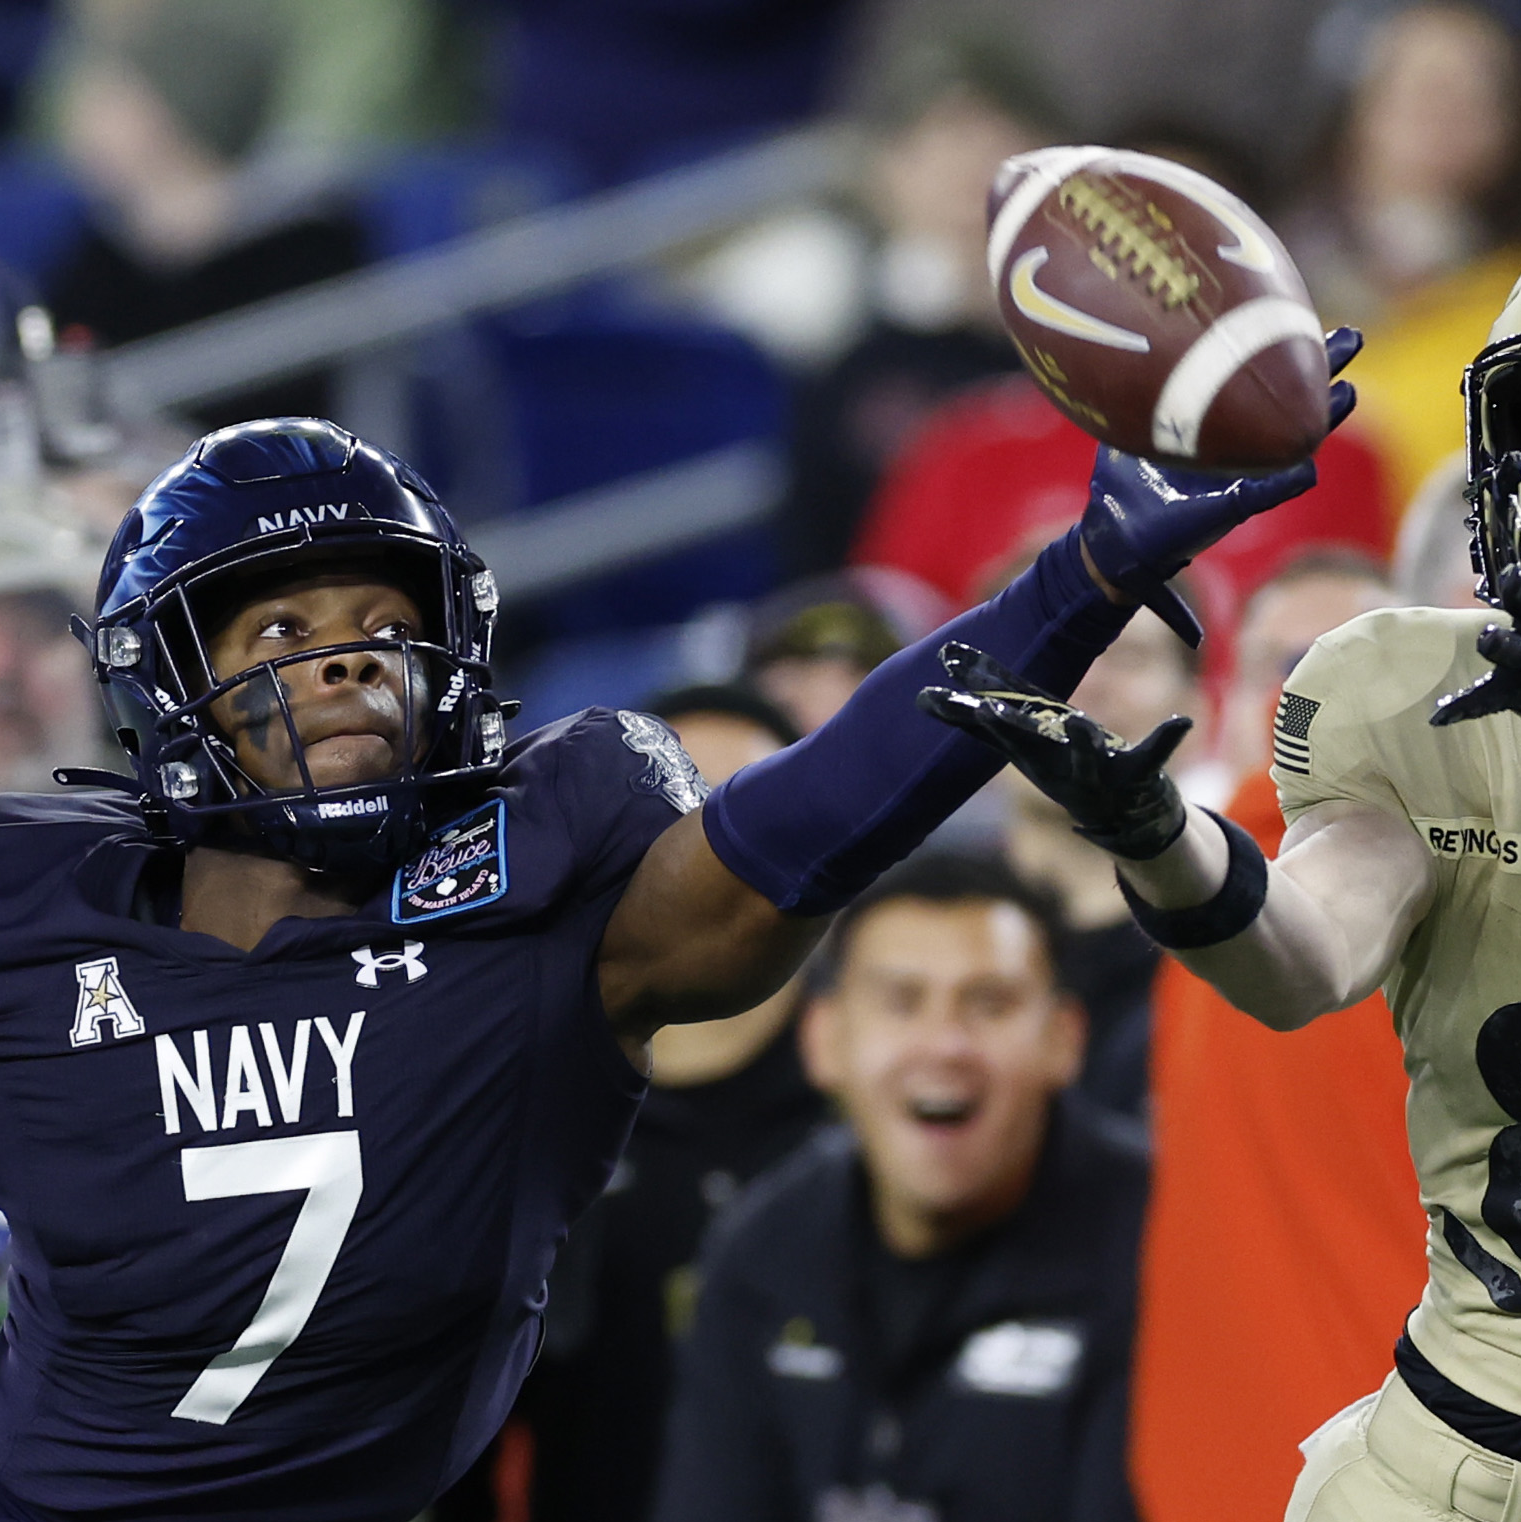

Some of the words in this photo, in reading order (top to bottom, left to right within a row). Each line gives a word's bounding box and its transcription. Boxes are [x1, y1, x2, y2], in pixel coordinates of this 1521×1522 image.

[257, 503, 348, 533] NAVY
[318, 795, 389, 820] Riddell
[407, 840, 491, 889] Deuce
[69, 956, 146, 1047] A
[155, 1011, 366, 1135] NAVY
[171, 1130, 363, 1425] 7
